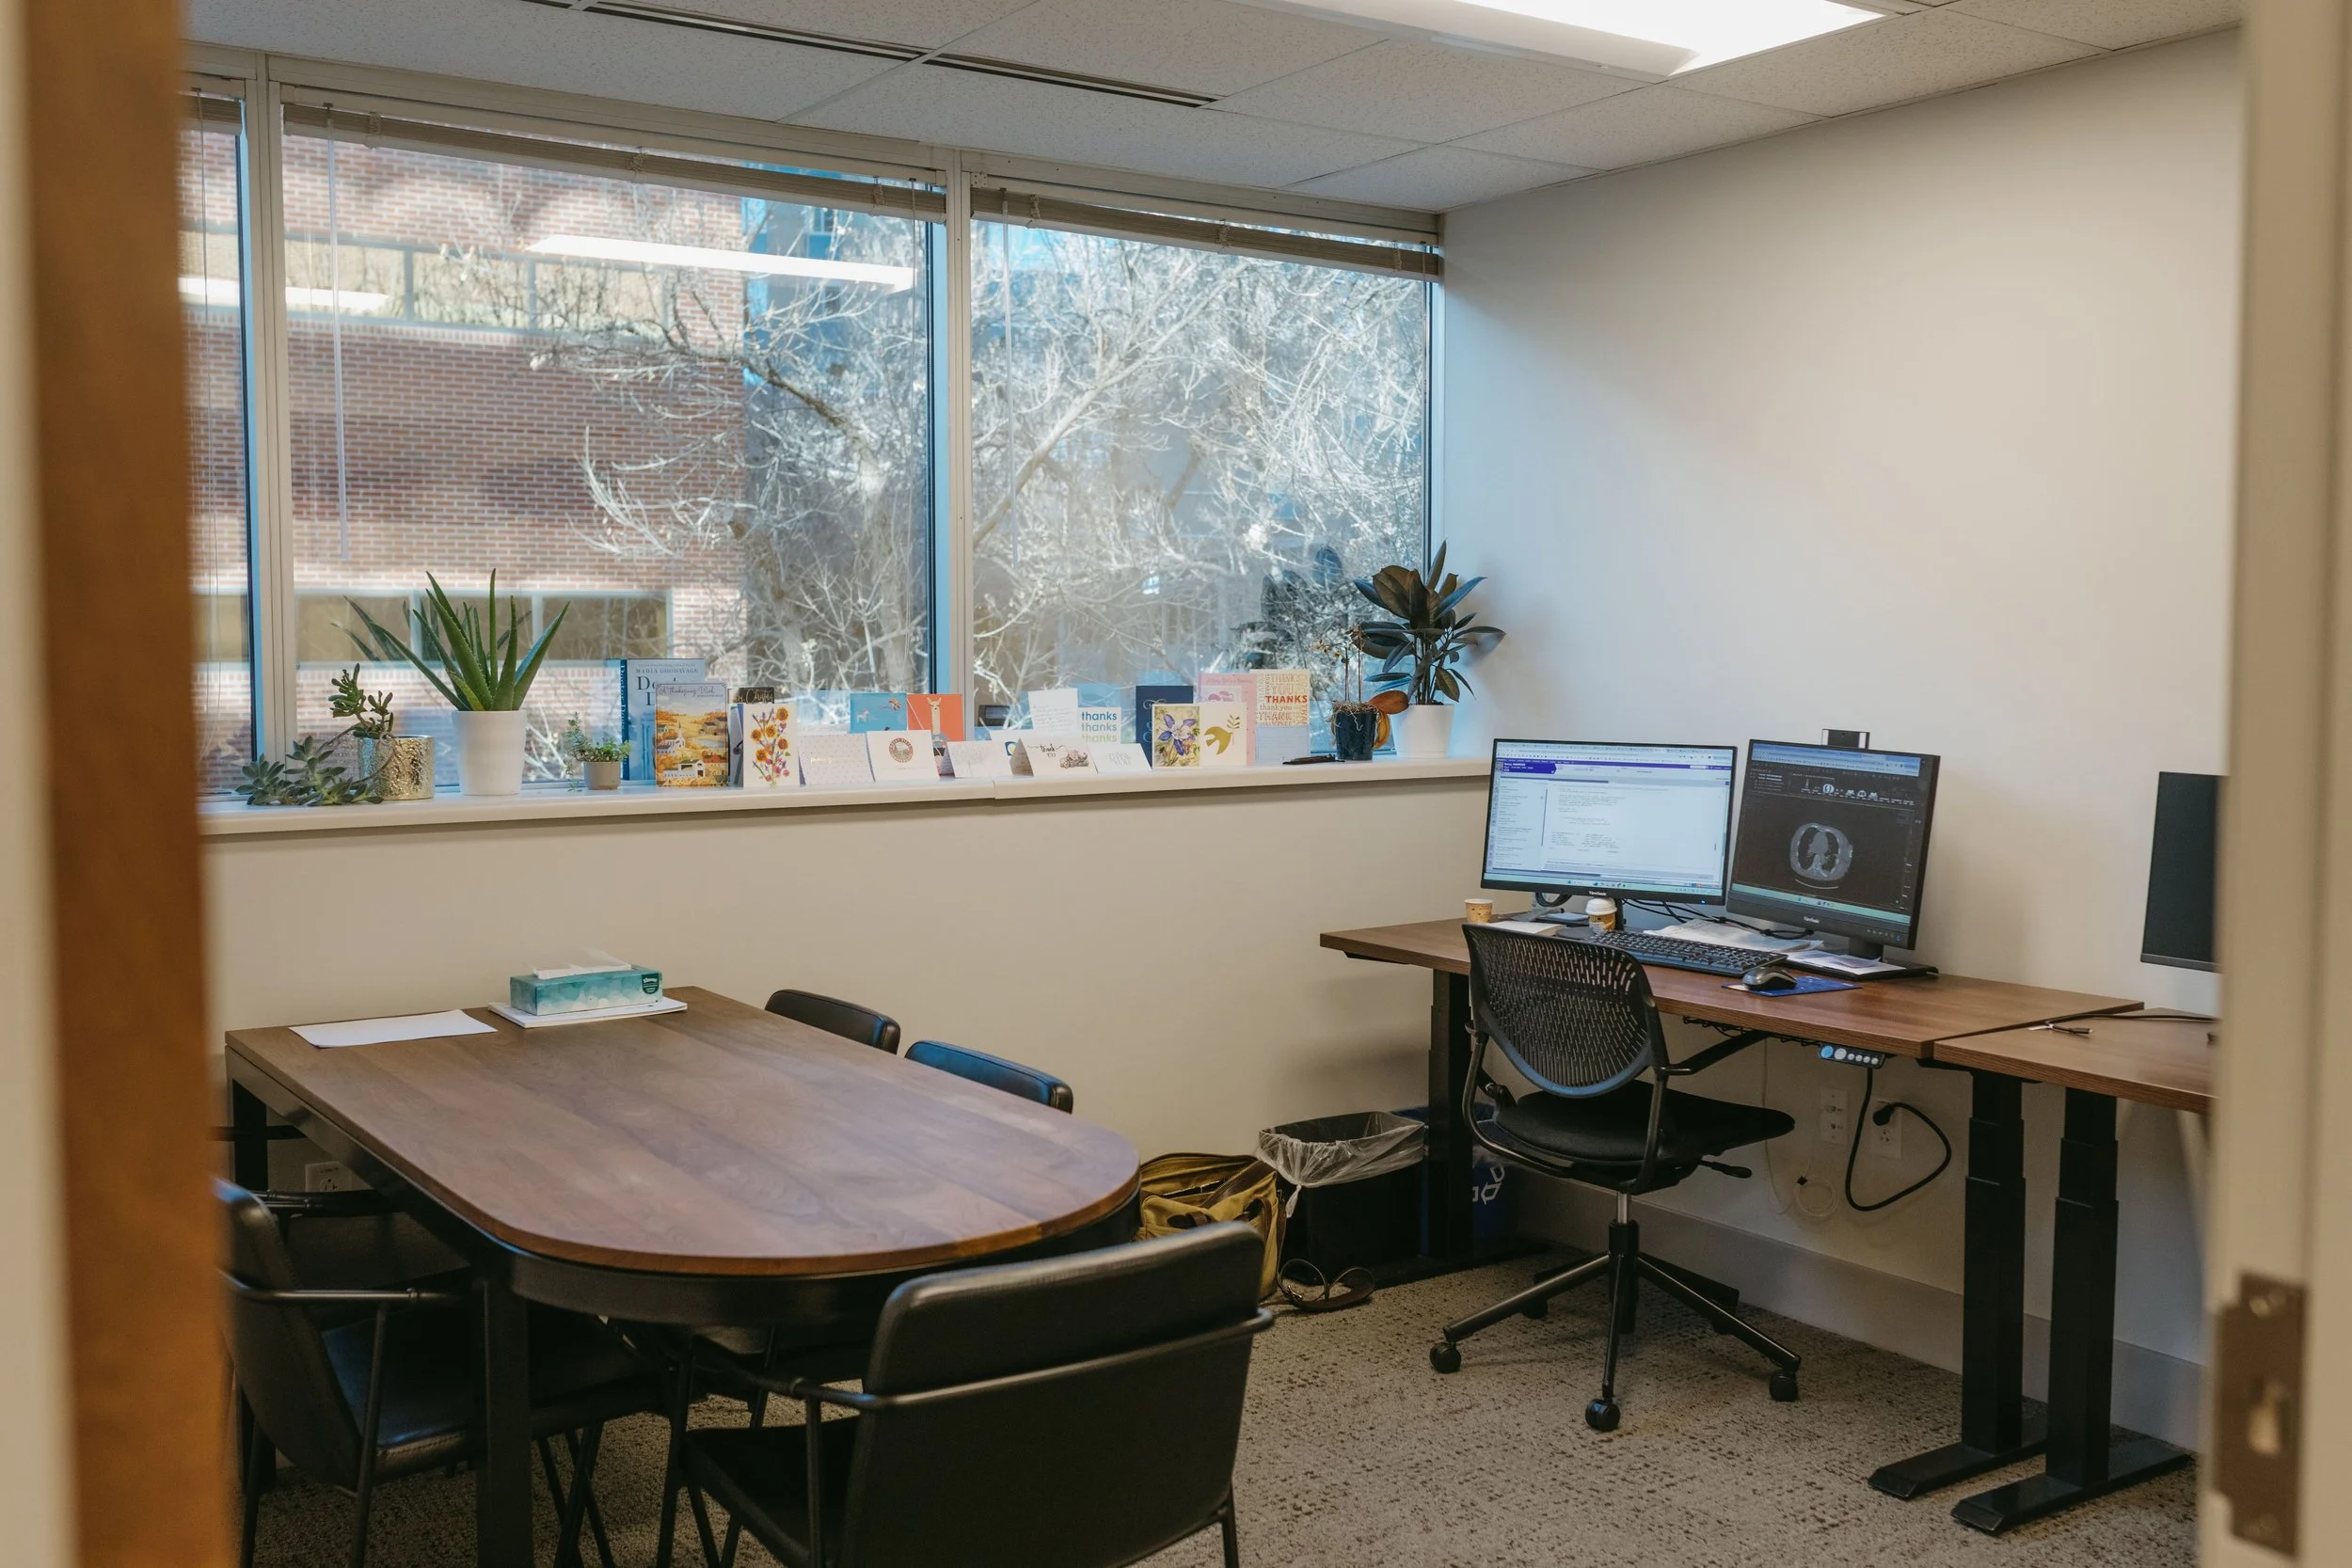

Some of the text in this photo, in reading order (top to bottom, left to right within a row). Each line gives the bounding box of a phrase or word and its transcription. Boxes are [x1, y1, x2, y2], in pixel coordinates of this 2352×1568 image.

[1264, 695, 1308, 704] THANKS
[1081, 711, 1117, 721] thanks
[1081, 722, 1117, 732] thanks
[1081, 734, 1117, 743] thanks
